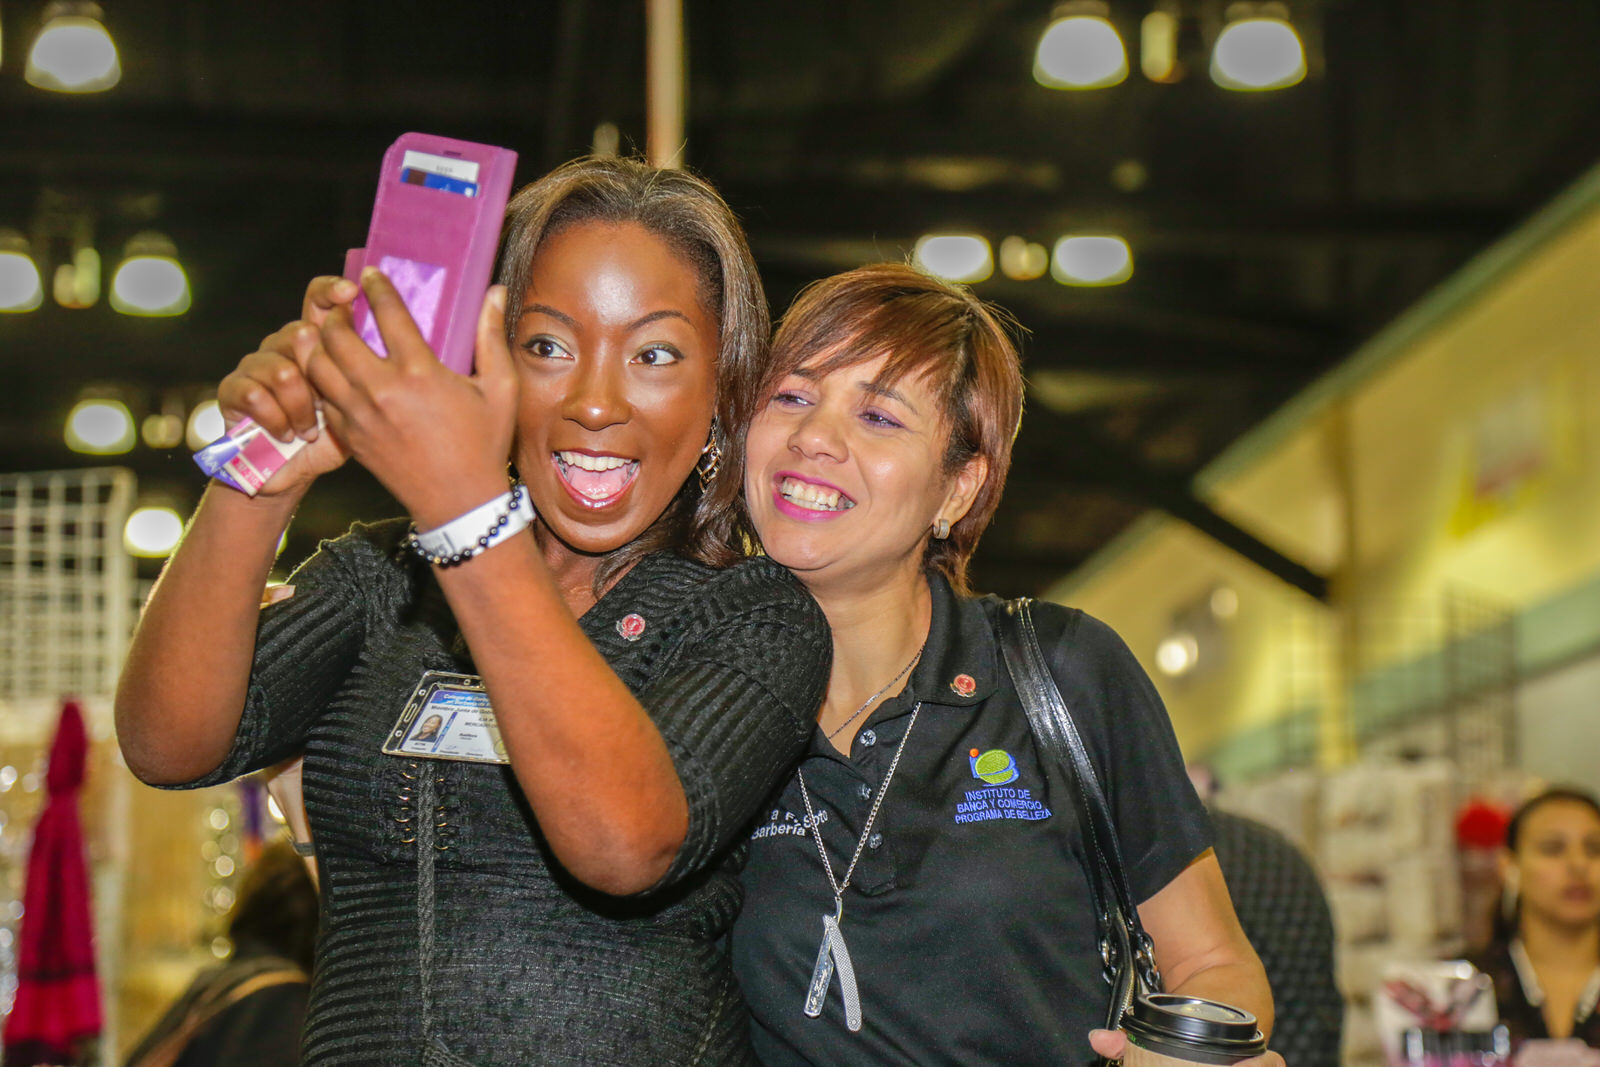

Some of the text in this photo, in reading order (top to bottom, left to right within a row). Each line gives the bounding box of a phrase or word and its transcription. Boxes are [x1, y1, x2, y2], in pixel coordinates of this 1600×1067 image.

[965, 788, 1031, 801] INSTITUTO DE
[957, 799, 1042, 814] BANCA Y COMERCIO
[803, 810, 829, 828] Soto
[955, 808, 1052, 824] PROGRAMA DE BELLEZA
